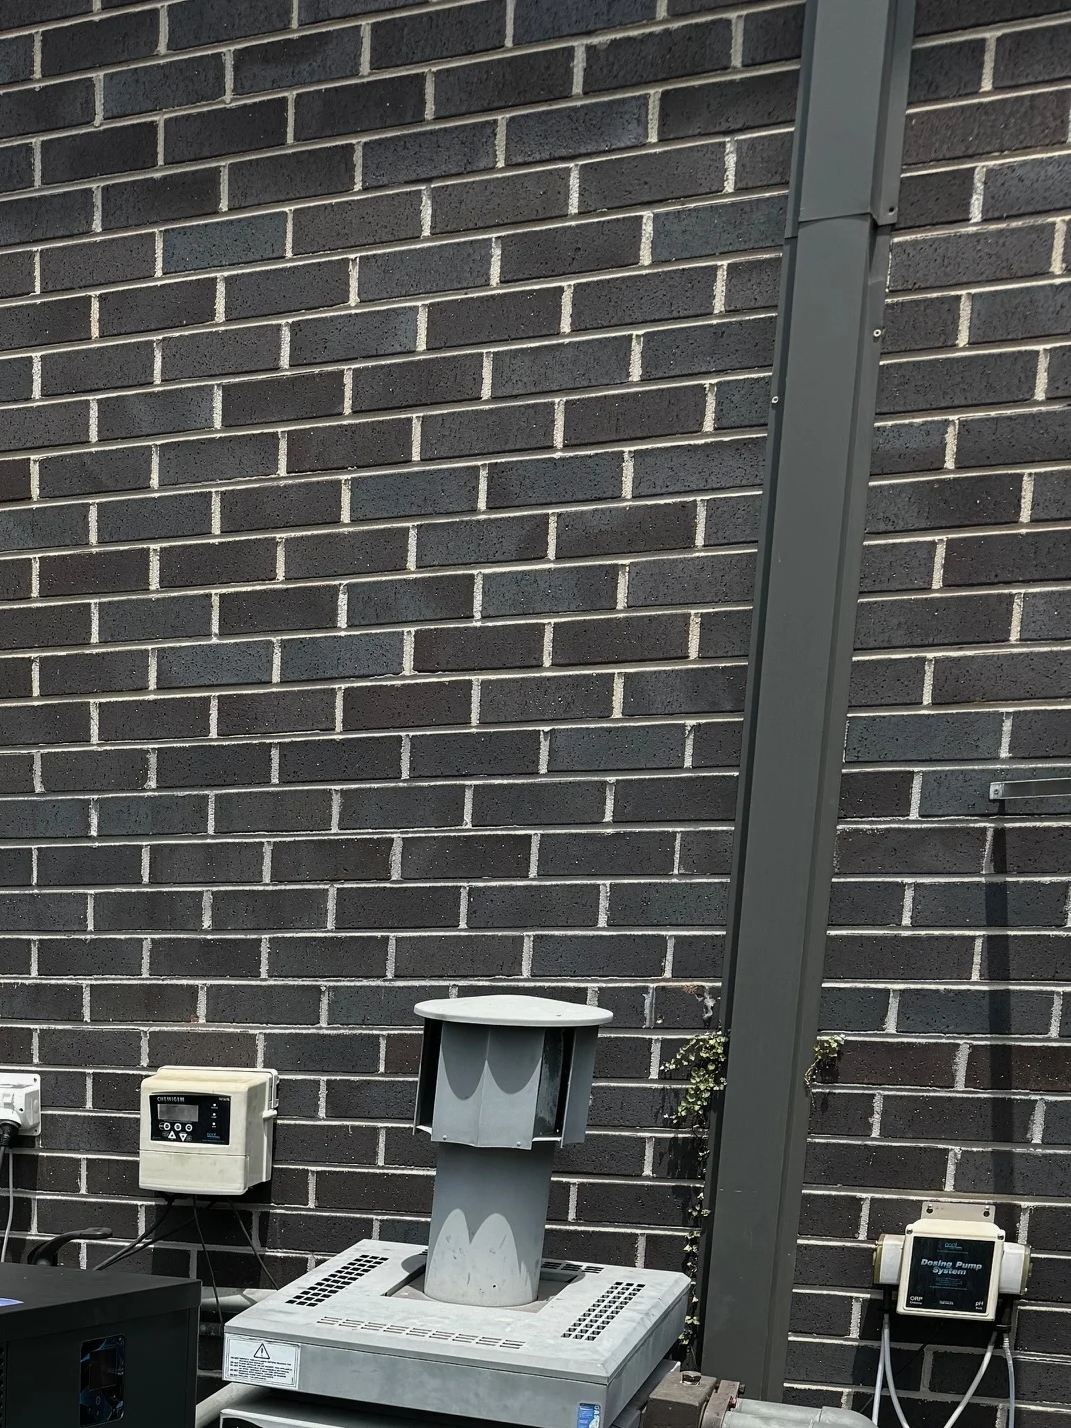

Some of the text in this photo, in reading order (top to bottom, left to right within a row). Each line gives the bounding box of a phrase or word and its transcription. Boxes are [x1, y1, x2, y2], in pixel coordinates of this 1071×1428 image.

[920, 1258, 983, 1271] Dosing Pump
[932, 1266, 967, 1275] System
